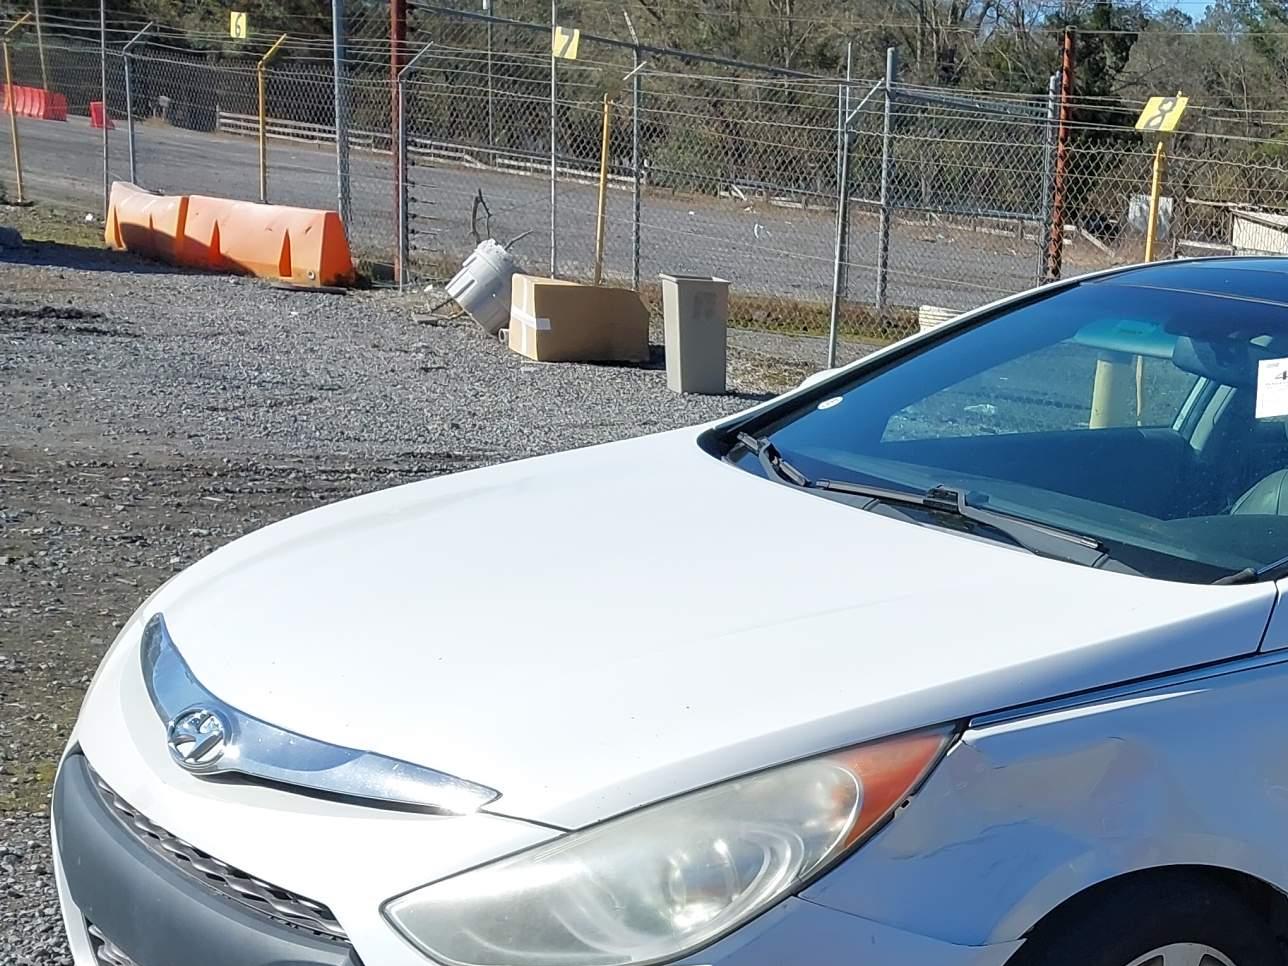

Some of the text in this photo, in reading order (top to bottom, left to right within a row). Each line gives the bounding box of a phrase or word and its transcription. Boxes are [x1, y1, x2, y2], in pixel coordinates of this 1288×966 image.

[235, 13, 242, 37] 6
[559, 28, 575, 58] 7
[1143, 97, 1177, 129] 8
